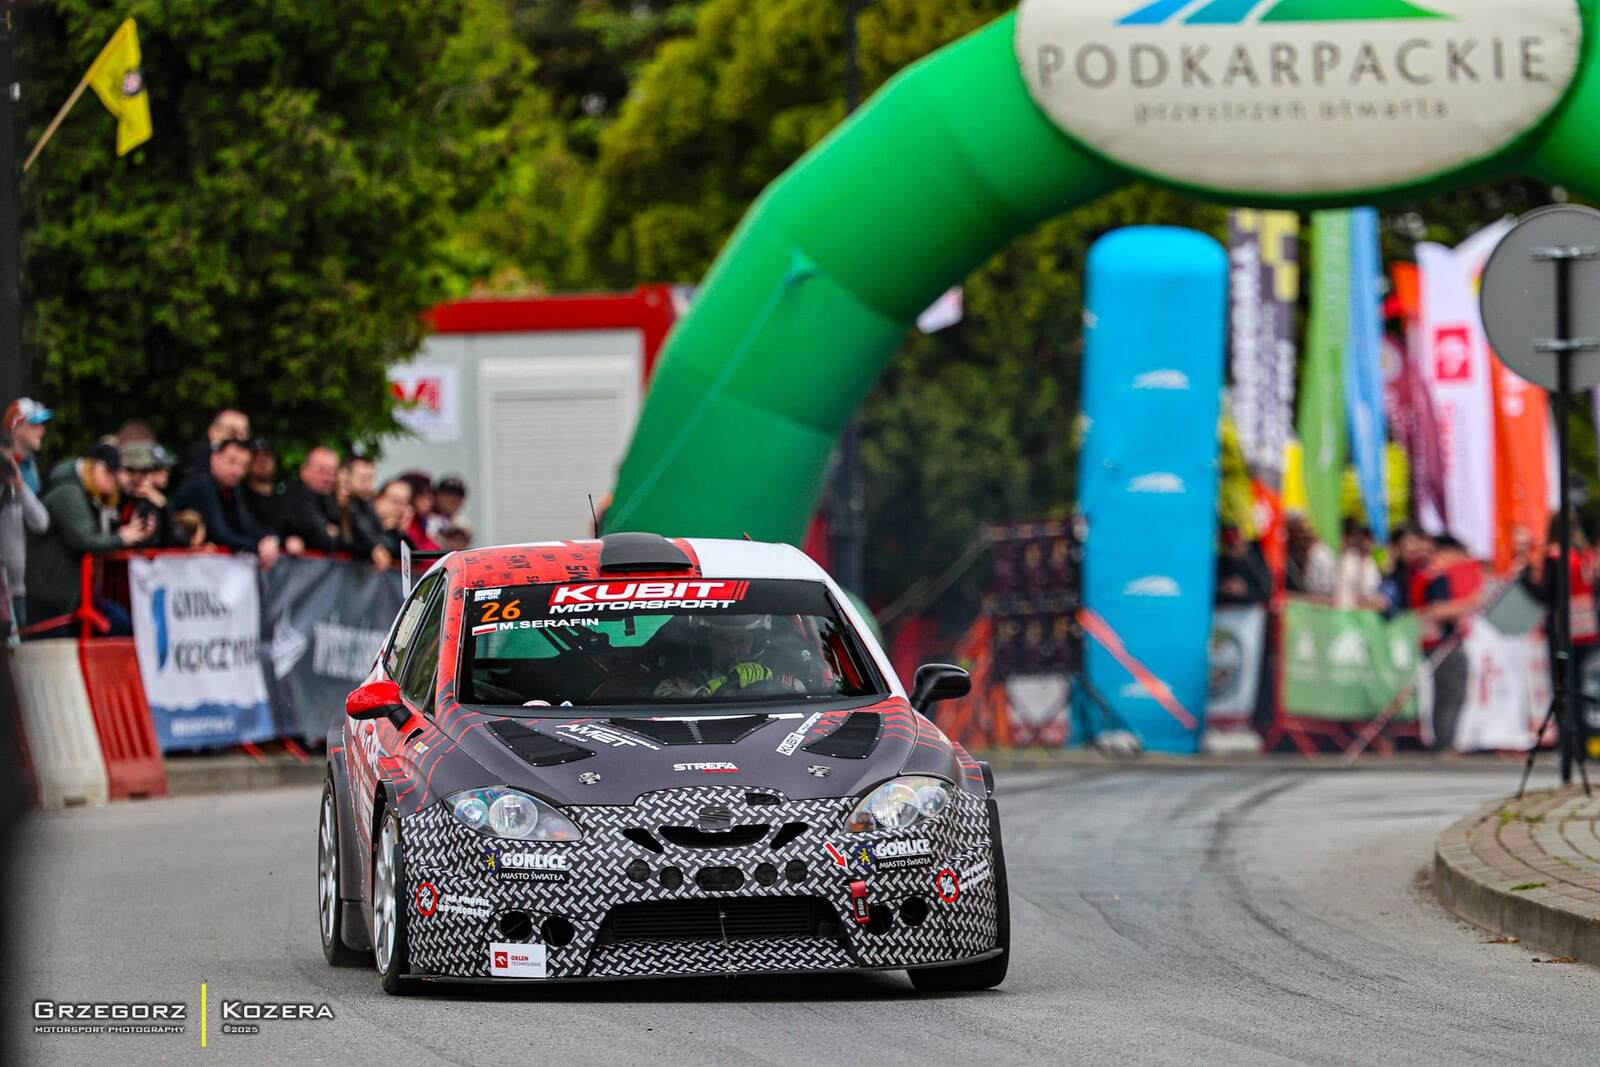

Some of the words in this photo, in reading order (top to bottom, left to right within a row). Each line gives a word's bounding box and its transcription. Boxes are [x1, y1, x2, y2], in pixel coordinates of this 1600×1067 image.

[1036, 37, 1550, 90] PODKARPACKIE
[552, 581, 728, 603] KUBIT
[480, 599, 521, 623] 26
[549, 600, 736, 614] MOTORSPORT
[499, 618, 600, 631] M.SERAFIN
[779, 734, 803, 754] KUBIT
[673, 762, 738, 772] STREFA
[875, 839, 931, 857] GORLICE
[501, 853, 567, 869] GORLICE
[879, 860, 906, 870] MIASTO
[501, 872, 529, 880] MIASTO
[530, 871, 565, 881] ŚWIATŁA
